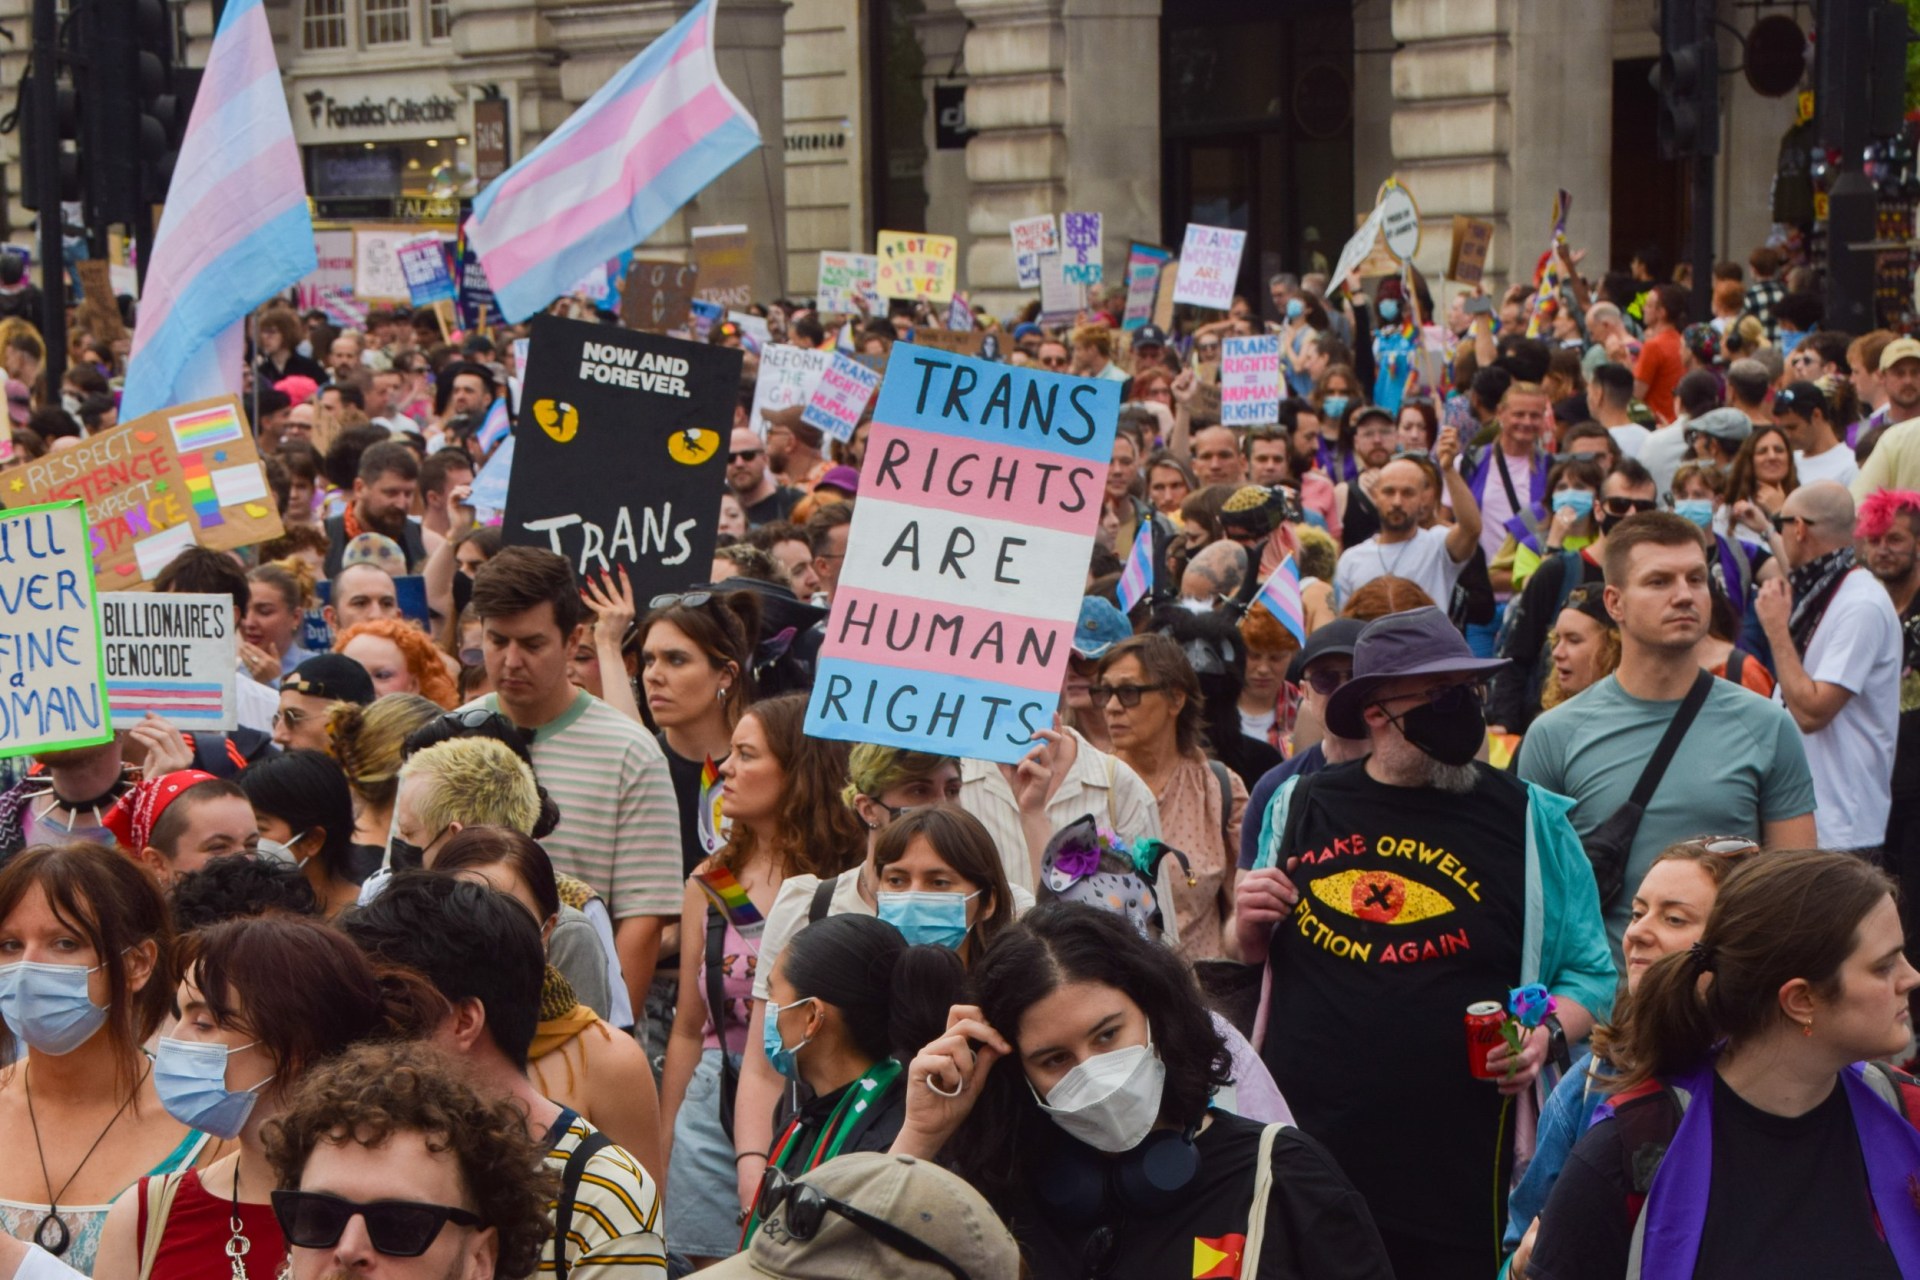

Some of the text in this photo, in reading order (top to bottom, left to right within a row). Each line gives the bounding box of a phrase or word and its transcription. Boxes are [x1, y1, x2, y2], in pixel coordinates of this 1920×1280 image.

[326, 97, 384, 127] Fanatics
[886, 238, 951, 259] PROTECT
[1188, 228, 1242, 250] TRANS
[1184, 250, 1237, 268] WOMEN
[1195, 267, 1221, 279] ARE
[896, 277, 942, 294] LIVES
[1178, 280, 1231, 298] WOMEN
[582, 341, 690, 377] NOW AND
[762, 347, 824, 372] REFORM
[1225, 337, 1278, 355] TRANS
[579, 361, 691, 398] FOREVER.
[779, 369, 805, 387] THE
[832, 354, 881, 389] TRANS
[1223, 356, 1278, 373] RIGHTS
[822, 367, 870, 403] RIGHTS
[914, 357, 1098, 445] TRANS
[1222, 384, 1279, 401] HUMAN
[801, 404, 853, 440] RIGHTS
[810, 390, 860, 424] HUMAN
[1222, 402, 1278, 419] RIGHTS
[30, 428, 134, 493] RESPECT
[876, 438, 1094, 513] RIGHTS
[89, 493, 188, 557] STANCE
[518, 501, 697, 576] TRANS
[882, 521, 1027, 584] ARE
[103, 602, 225, 639] BILLIONAIRES
[838, 600, 1057, 667] HUMAN
[106, 643, 193, 677] GENOCIDE
[820, 674, 1043, 745] RIGHTS
[1376, 835, 1482, 902] ORWELL
[1296, 898, 1470, 963] FICTION AGAIN
